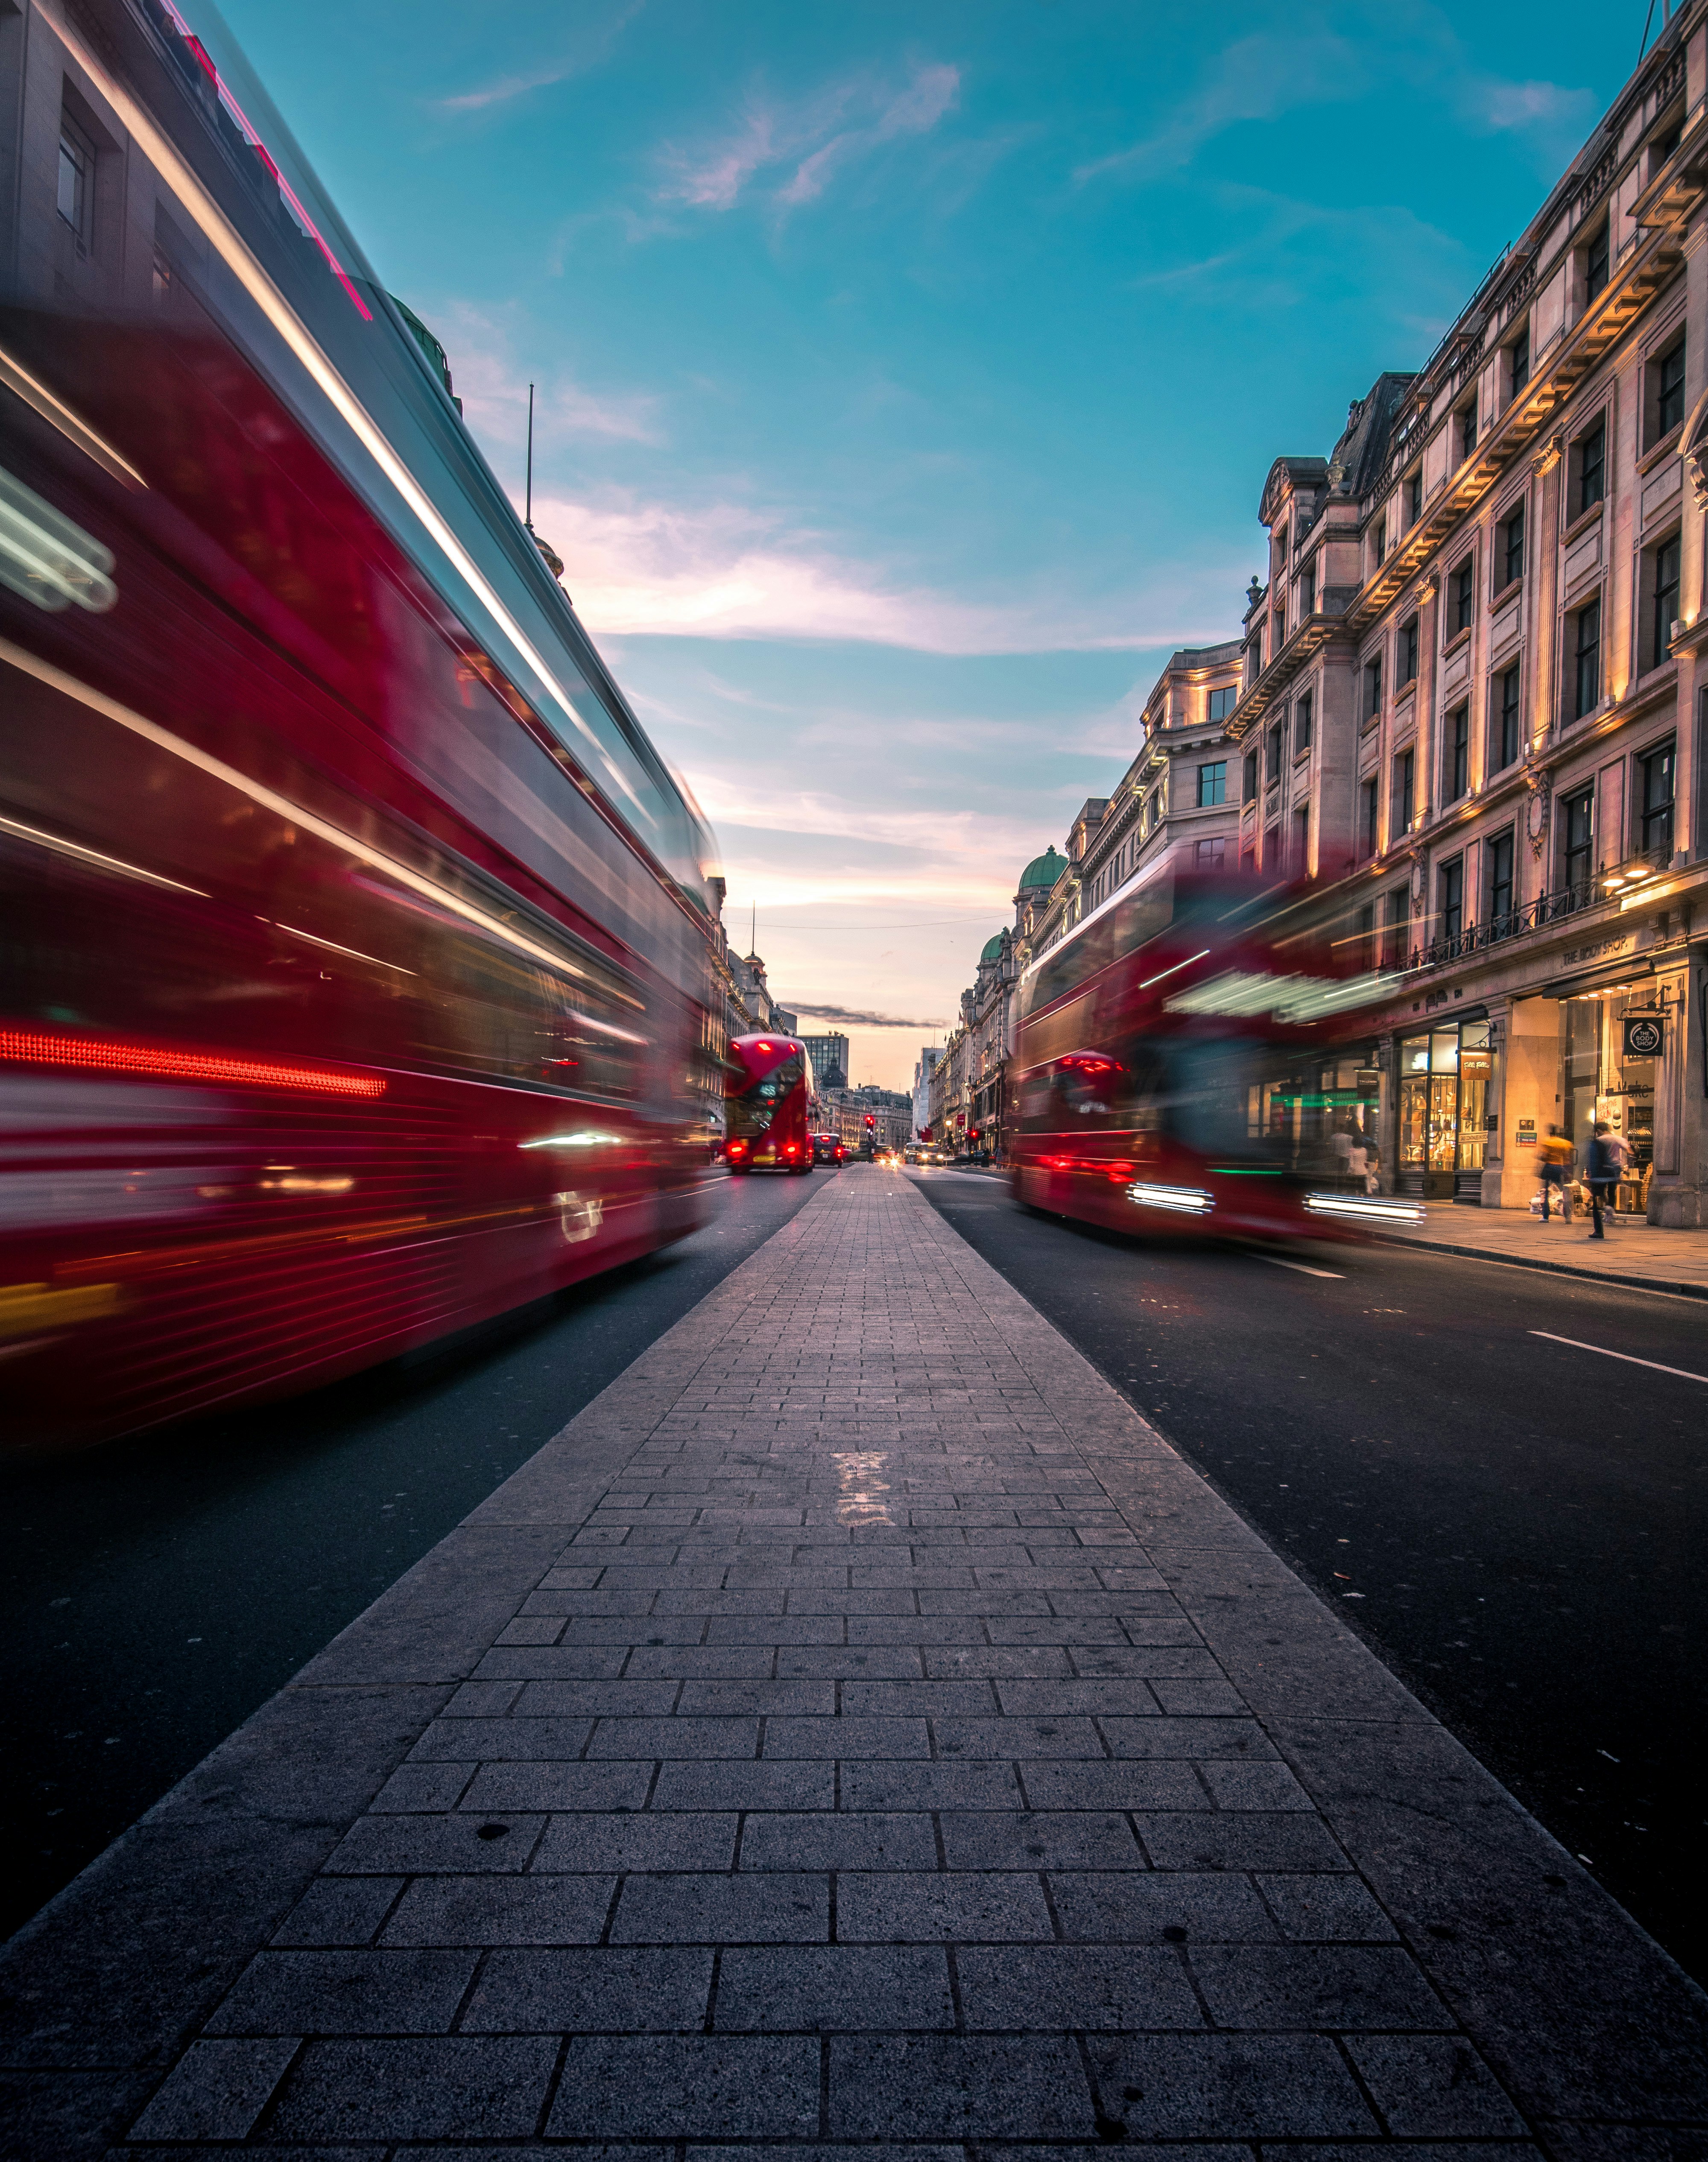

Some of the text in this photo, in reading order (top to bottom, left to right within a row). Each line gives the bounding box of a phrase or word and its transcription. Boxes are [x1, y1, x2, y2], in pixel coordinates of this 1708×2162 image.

[1563, 949, 1579, 966] THE
[1597, 1098, 1617, 1112] SENSITIVE
[1600, 1110, 1611, 1120] SKIN
